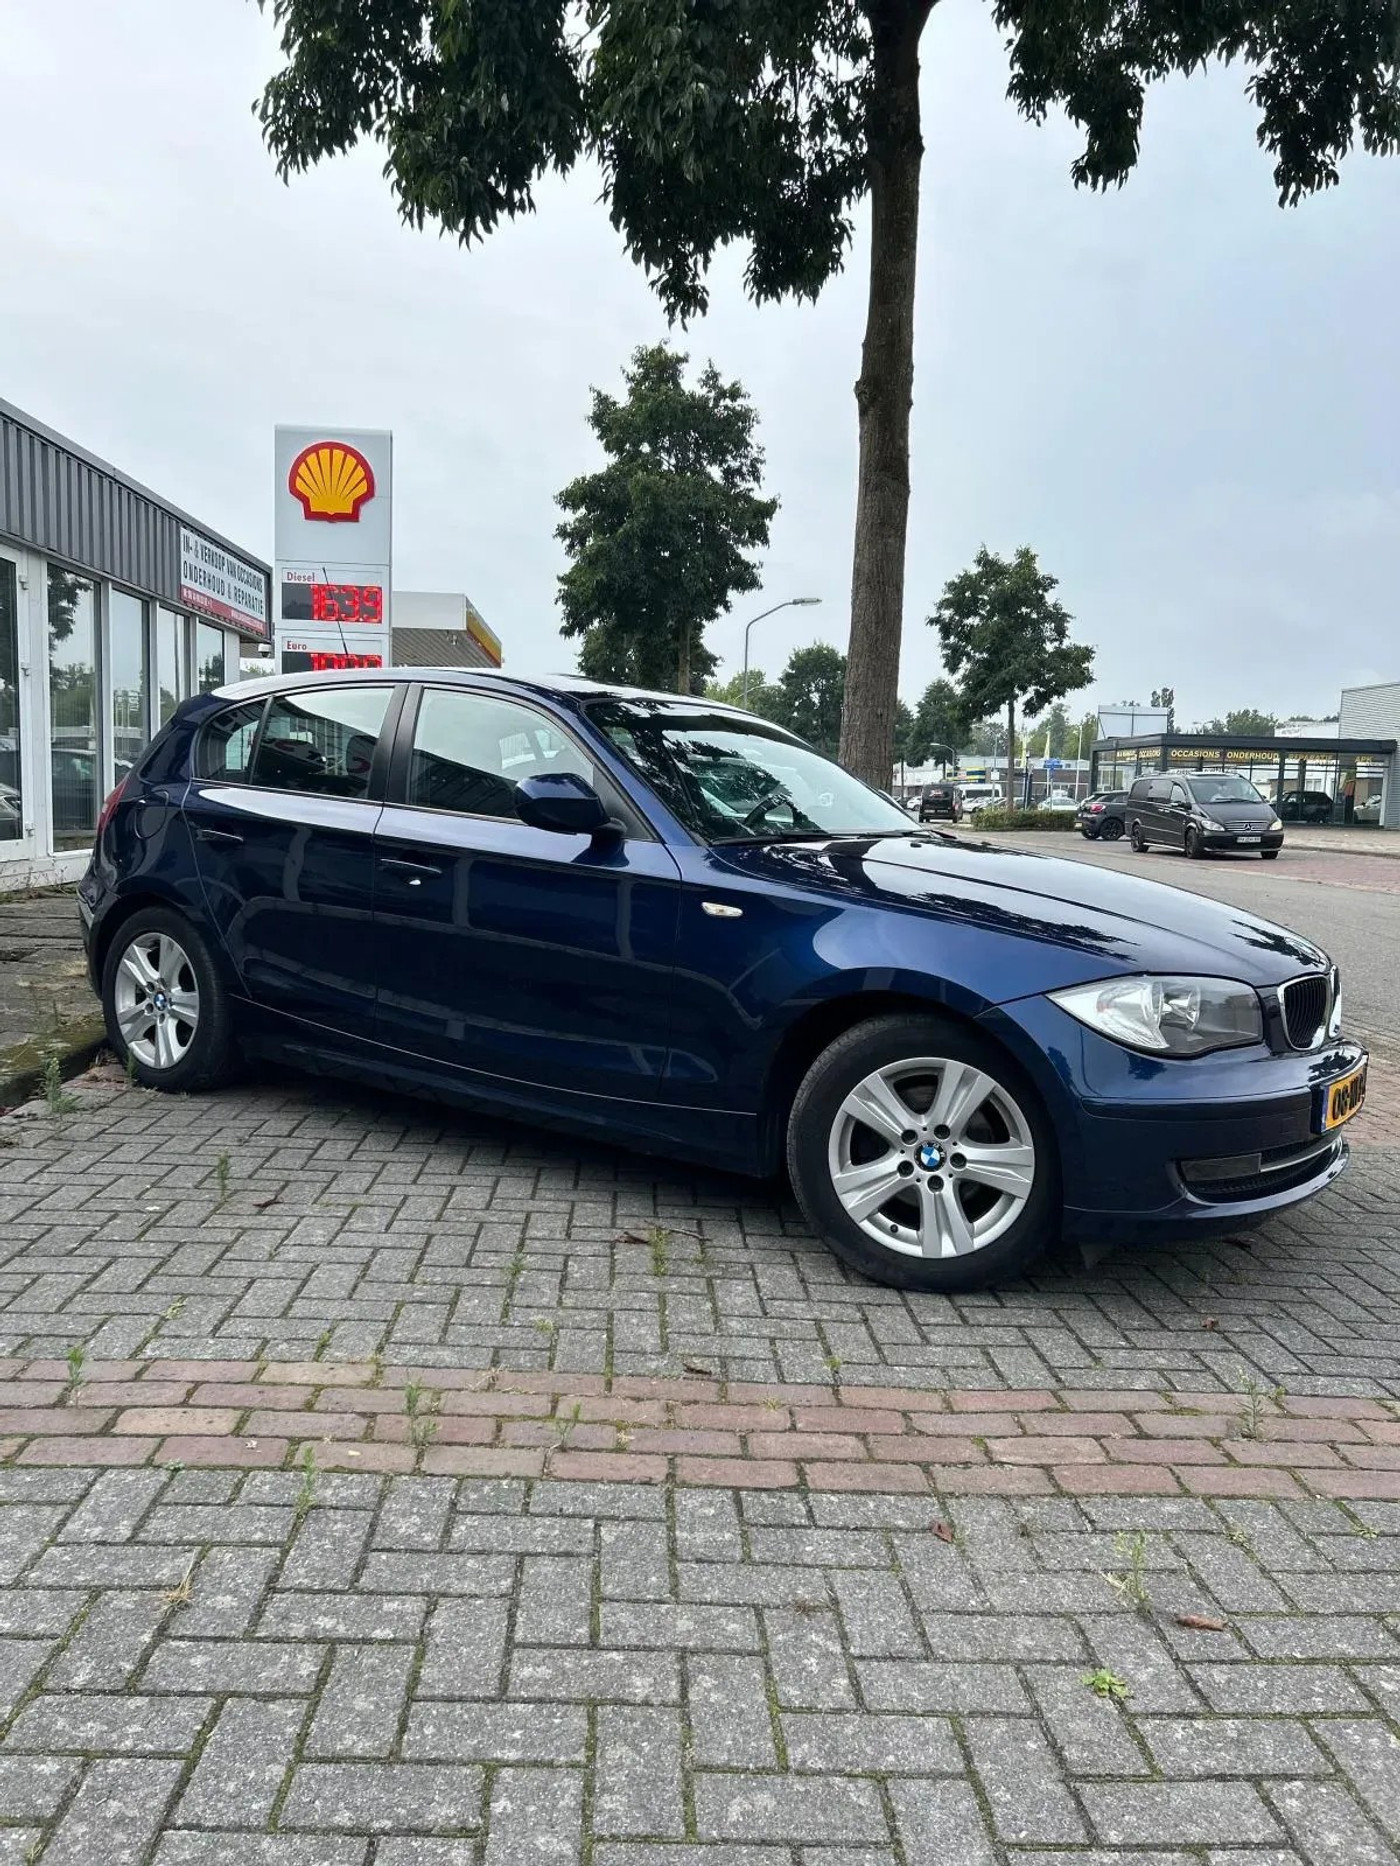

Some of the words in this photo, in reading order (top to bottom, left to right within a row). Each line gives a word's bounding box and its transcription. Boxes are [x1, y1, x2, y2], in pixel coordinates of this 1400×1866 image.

[200, 544, 226, 573] VERKOOP
[286, 571, 316, 583] Diesel
[183, 560, 226, 597] ONDERHOUD
[234, 585, 263, 616] REPARATIE
[286, 640, 308, 651] Euro
[1171, 749, 1221, 759] OCCASIONS
[1226, 751, 1280, 761] ONDERHOUD
